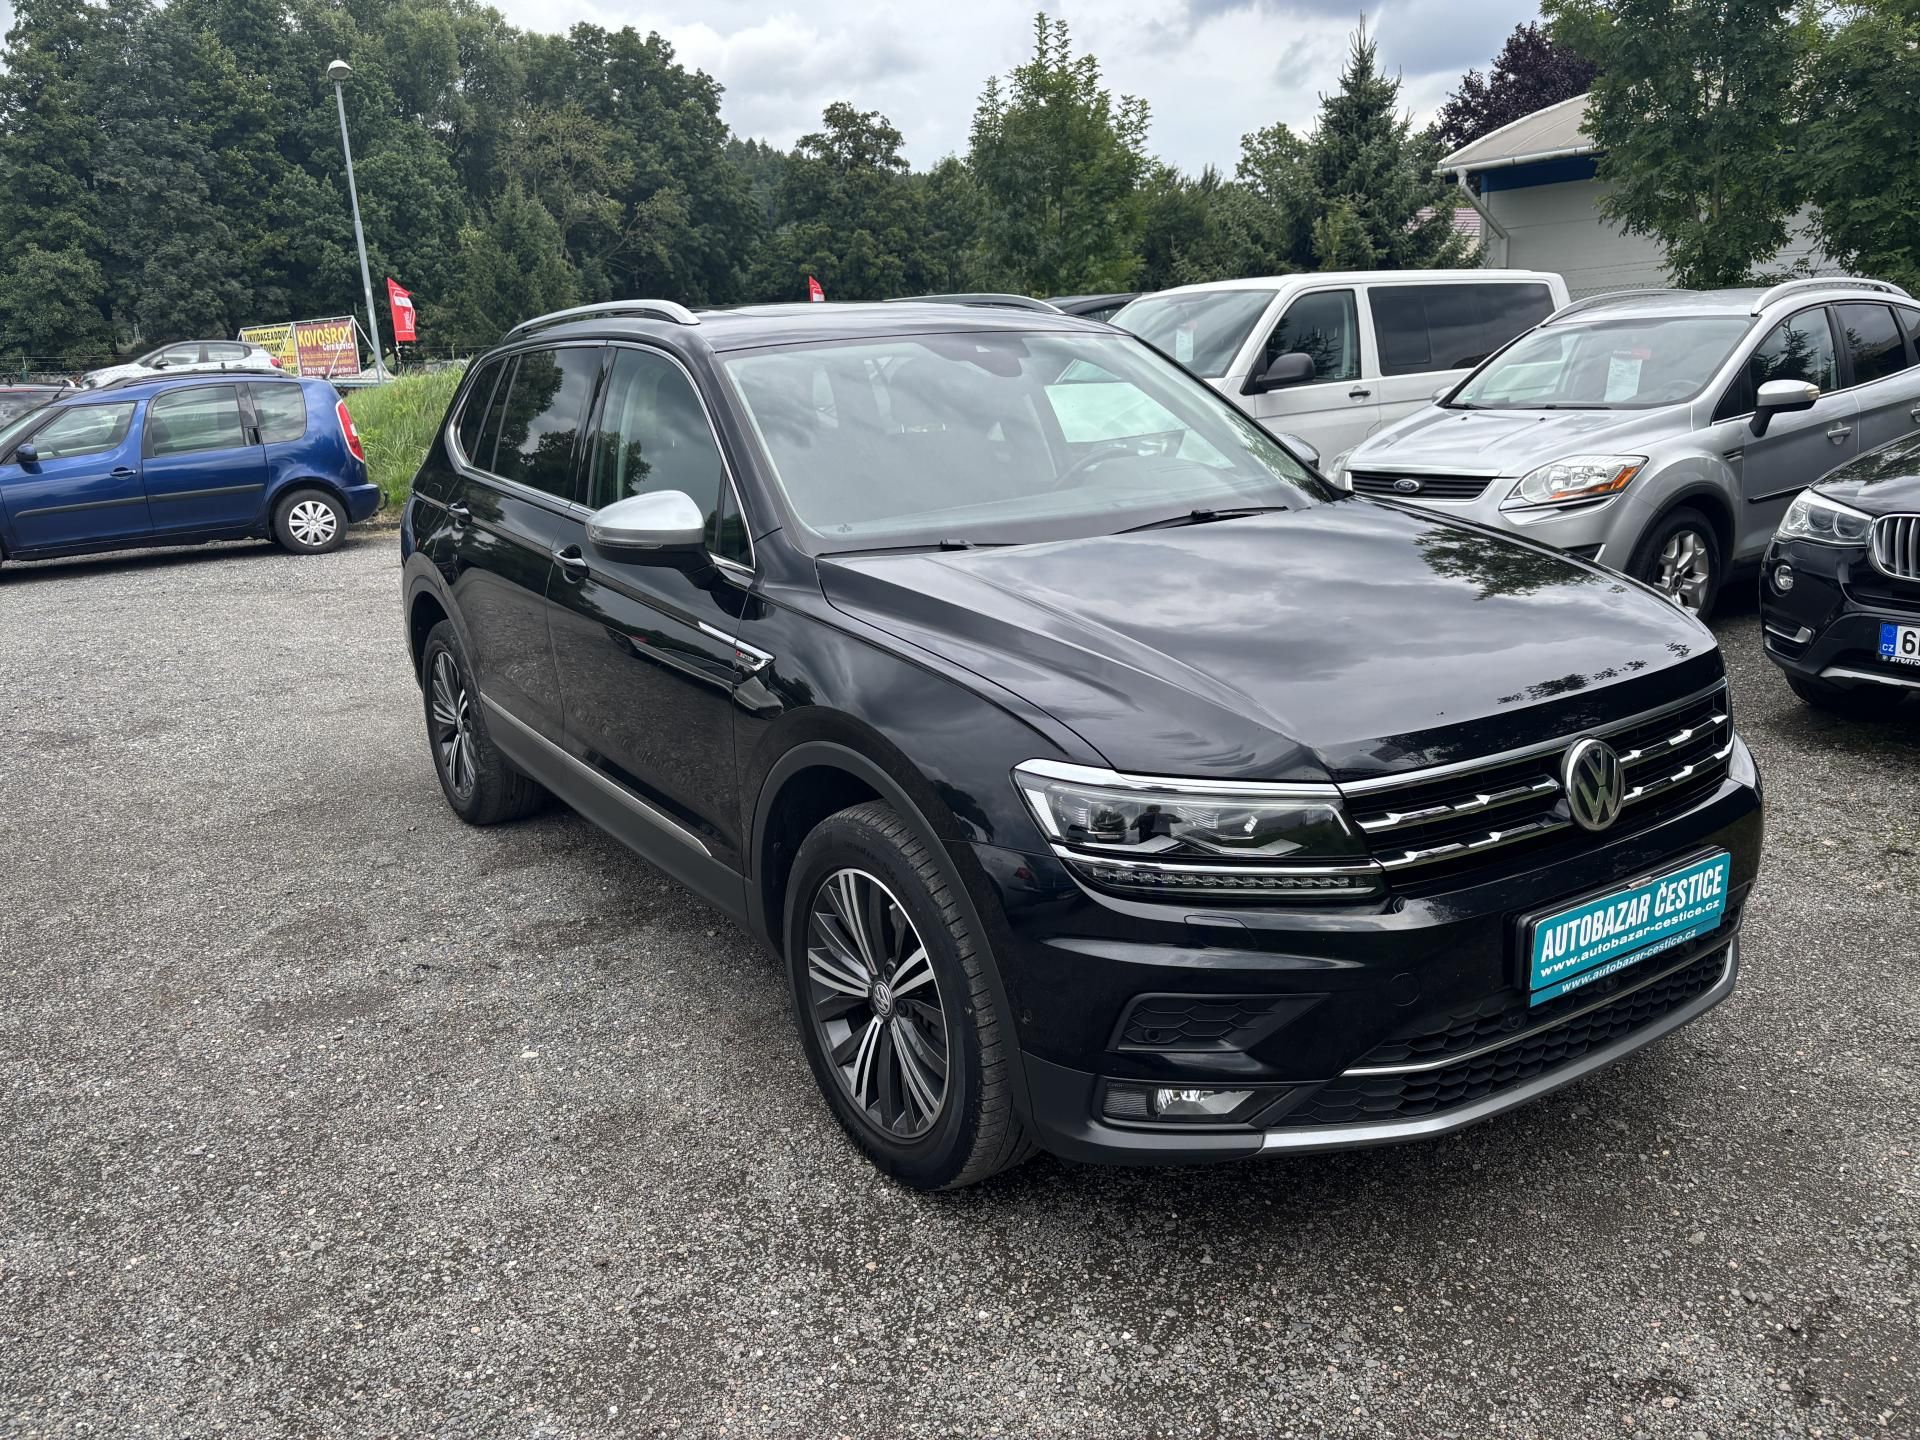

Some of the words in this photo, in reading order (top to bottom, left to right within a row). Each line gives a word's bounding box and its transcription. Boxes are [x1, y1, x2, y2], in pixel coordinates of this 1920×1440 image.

[297, 324, 352, 347] KOVOŠROT
[1882, 643, 1894, 652] CZ
[1902, 630, 1920, 656] 6
[1541, 893, 1650, 963] AUTOBAZAR
[1654, 864, 1724, 917] ČESTICE
[1540, 899, 1720, 977] www.autobazar-cestice.cz
[1561, 928, 1697, 993] www.autobazar-cestice.cz
